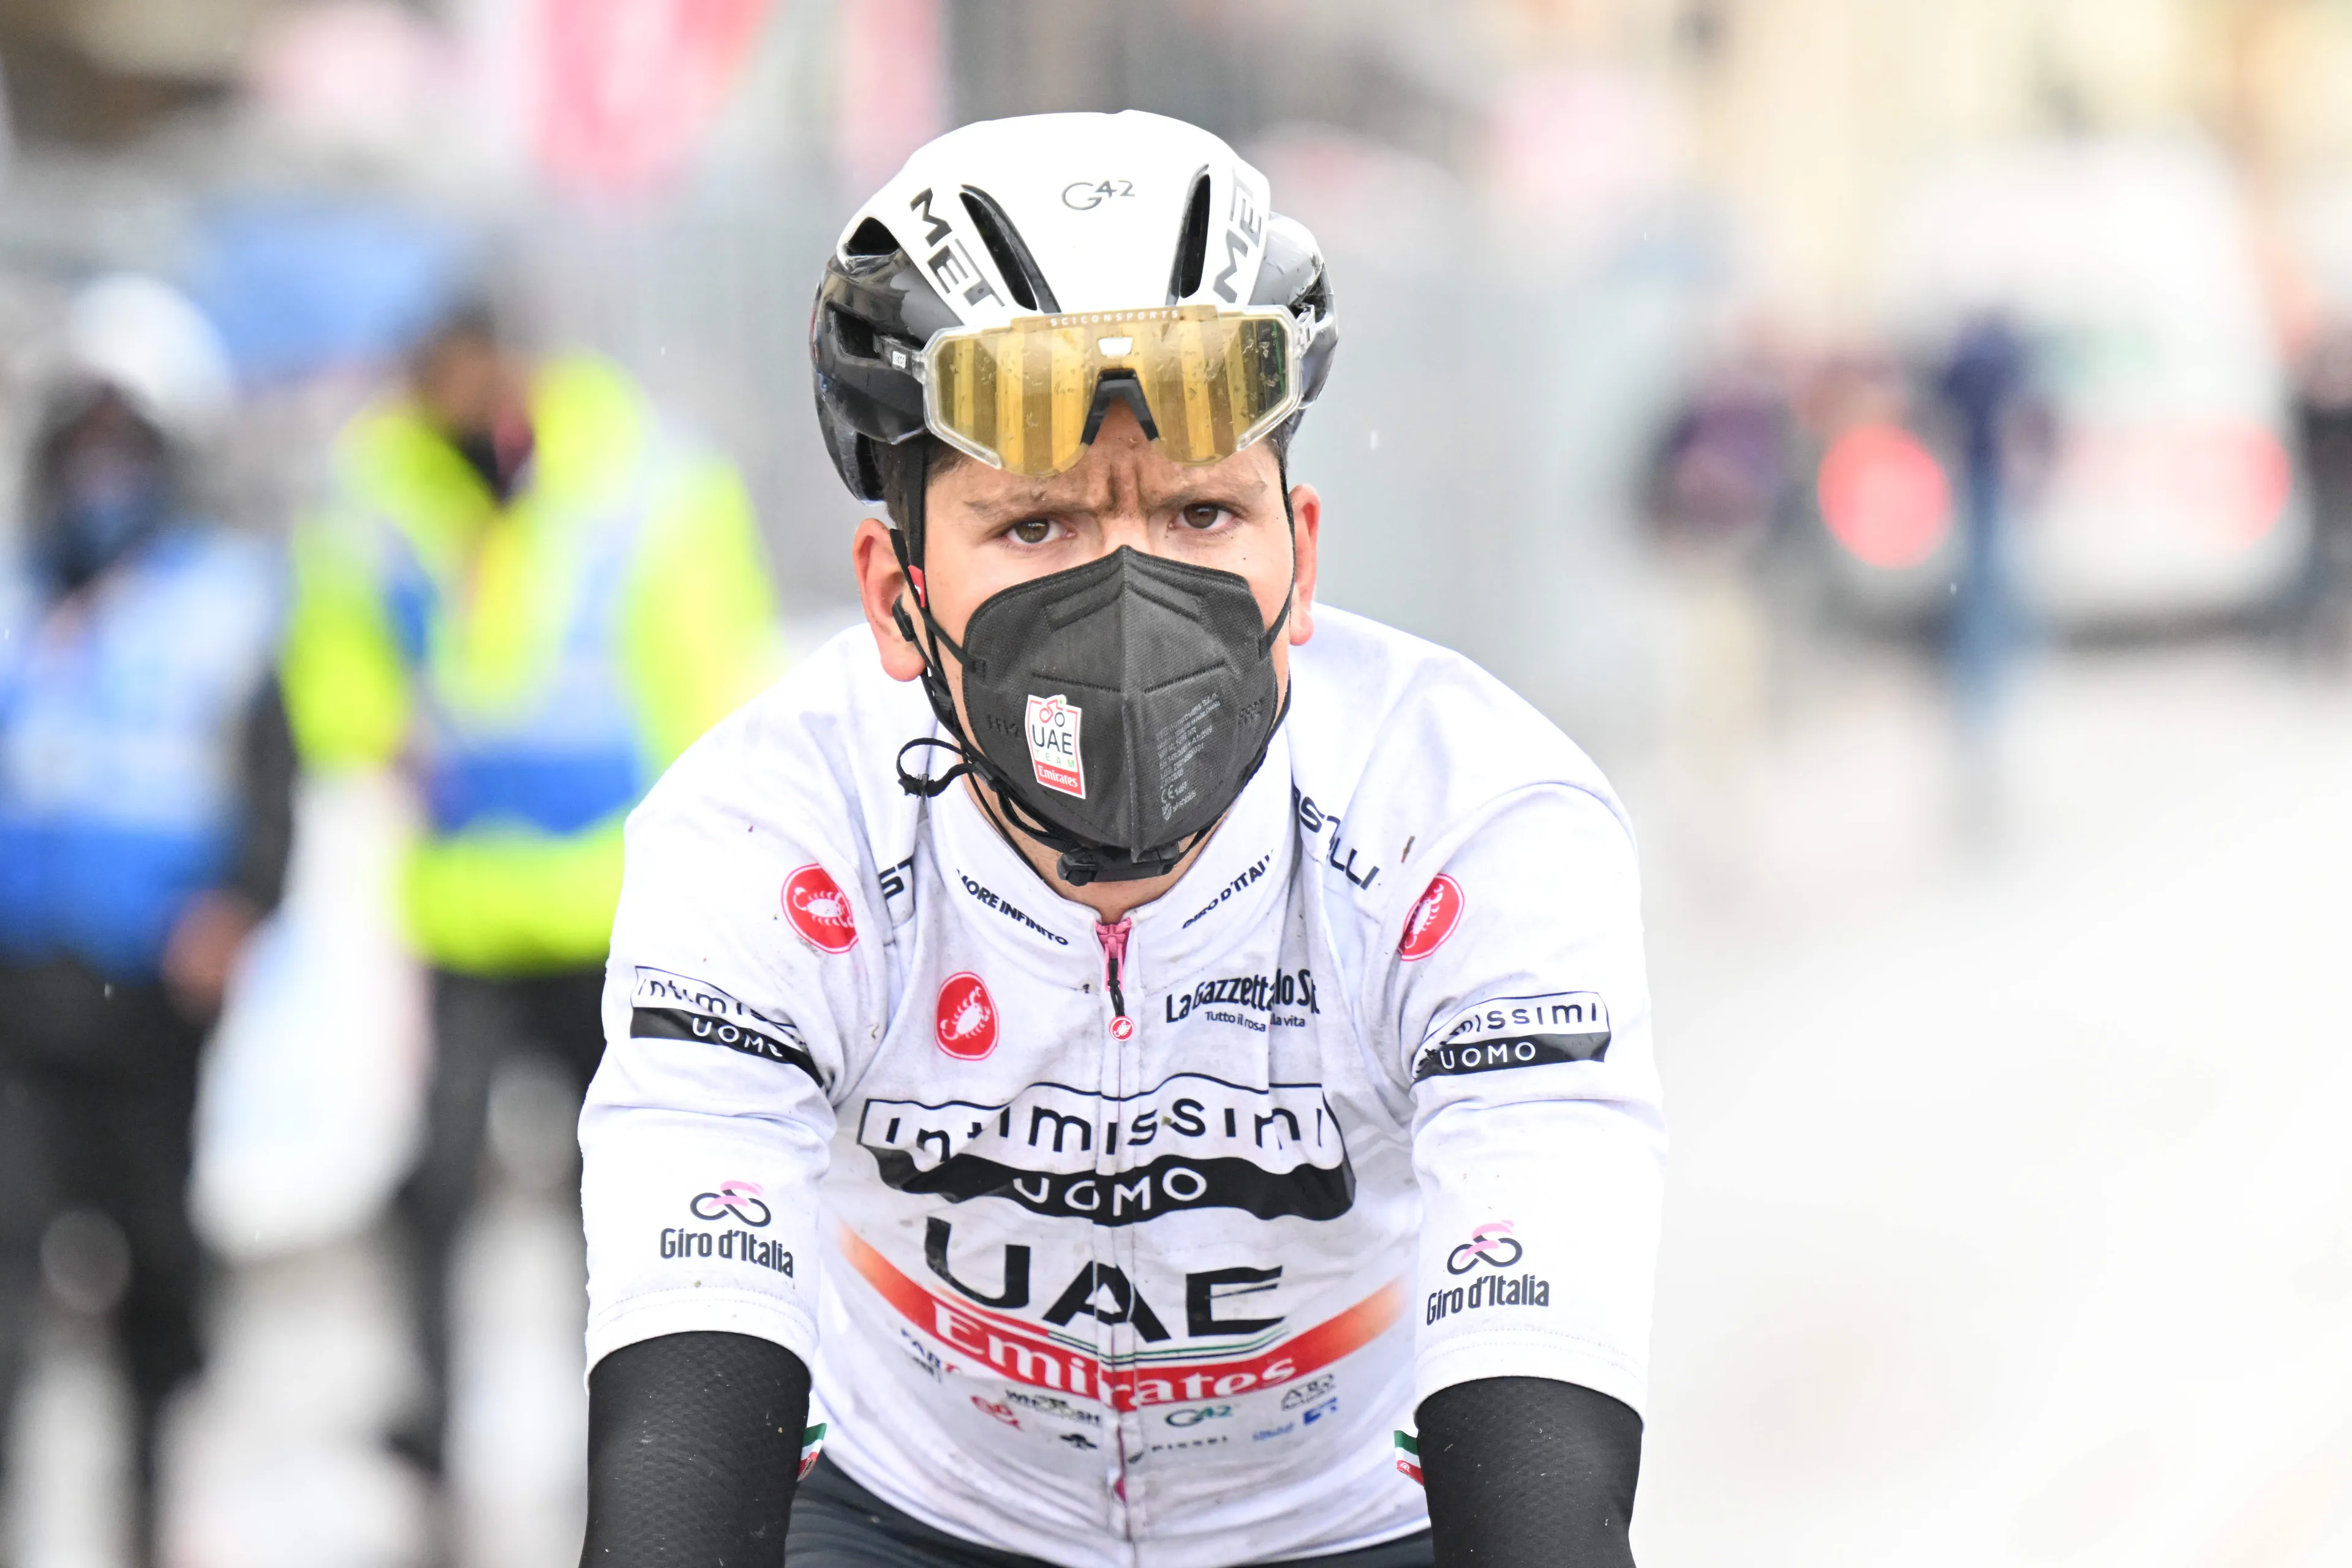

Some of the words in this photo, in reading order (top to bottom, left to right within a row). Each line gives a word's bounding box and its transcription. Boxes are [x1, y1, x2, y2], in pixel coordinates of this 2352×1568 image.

[1061, 180, 1136, 210] G42
[910, 187, 1005, 307] MET
[1050, 310, 1179, 326] SCICONSPORTS
[1032, 725, 1073, 755] UAE
[1035, 750, 1075, 768] TEAM
[1038, 765, 1078, 788] Emirates
[999, 900, 1069, 945] INFINITO
[1166, 993, 1192, 1023] La
[1205, 1011, 1235, 1023] Tutto
[1237, 1012, 1243, 1025] il
[1245, 1018, 1266, 1032] rosa
[1283, 1015, 1306, 1027] vita
[1440, 1041, 1536, 1069] UOMO
[1012, 1167, 1207, 1217] UOMO
[660, 1227, 712, 1259] Giro
[718, 1229, 793, 1279] d'Italia
[925, 1216, 1284, 1343] UAE
[1427, 1289, 1464, 1326] Giro
[1468, 1273, 1550, 1307] d'Italia
[931, 1298, 1296, 1408] Emirates
